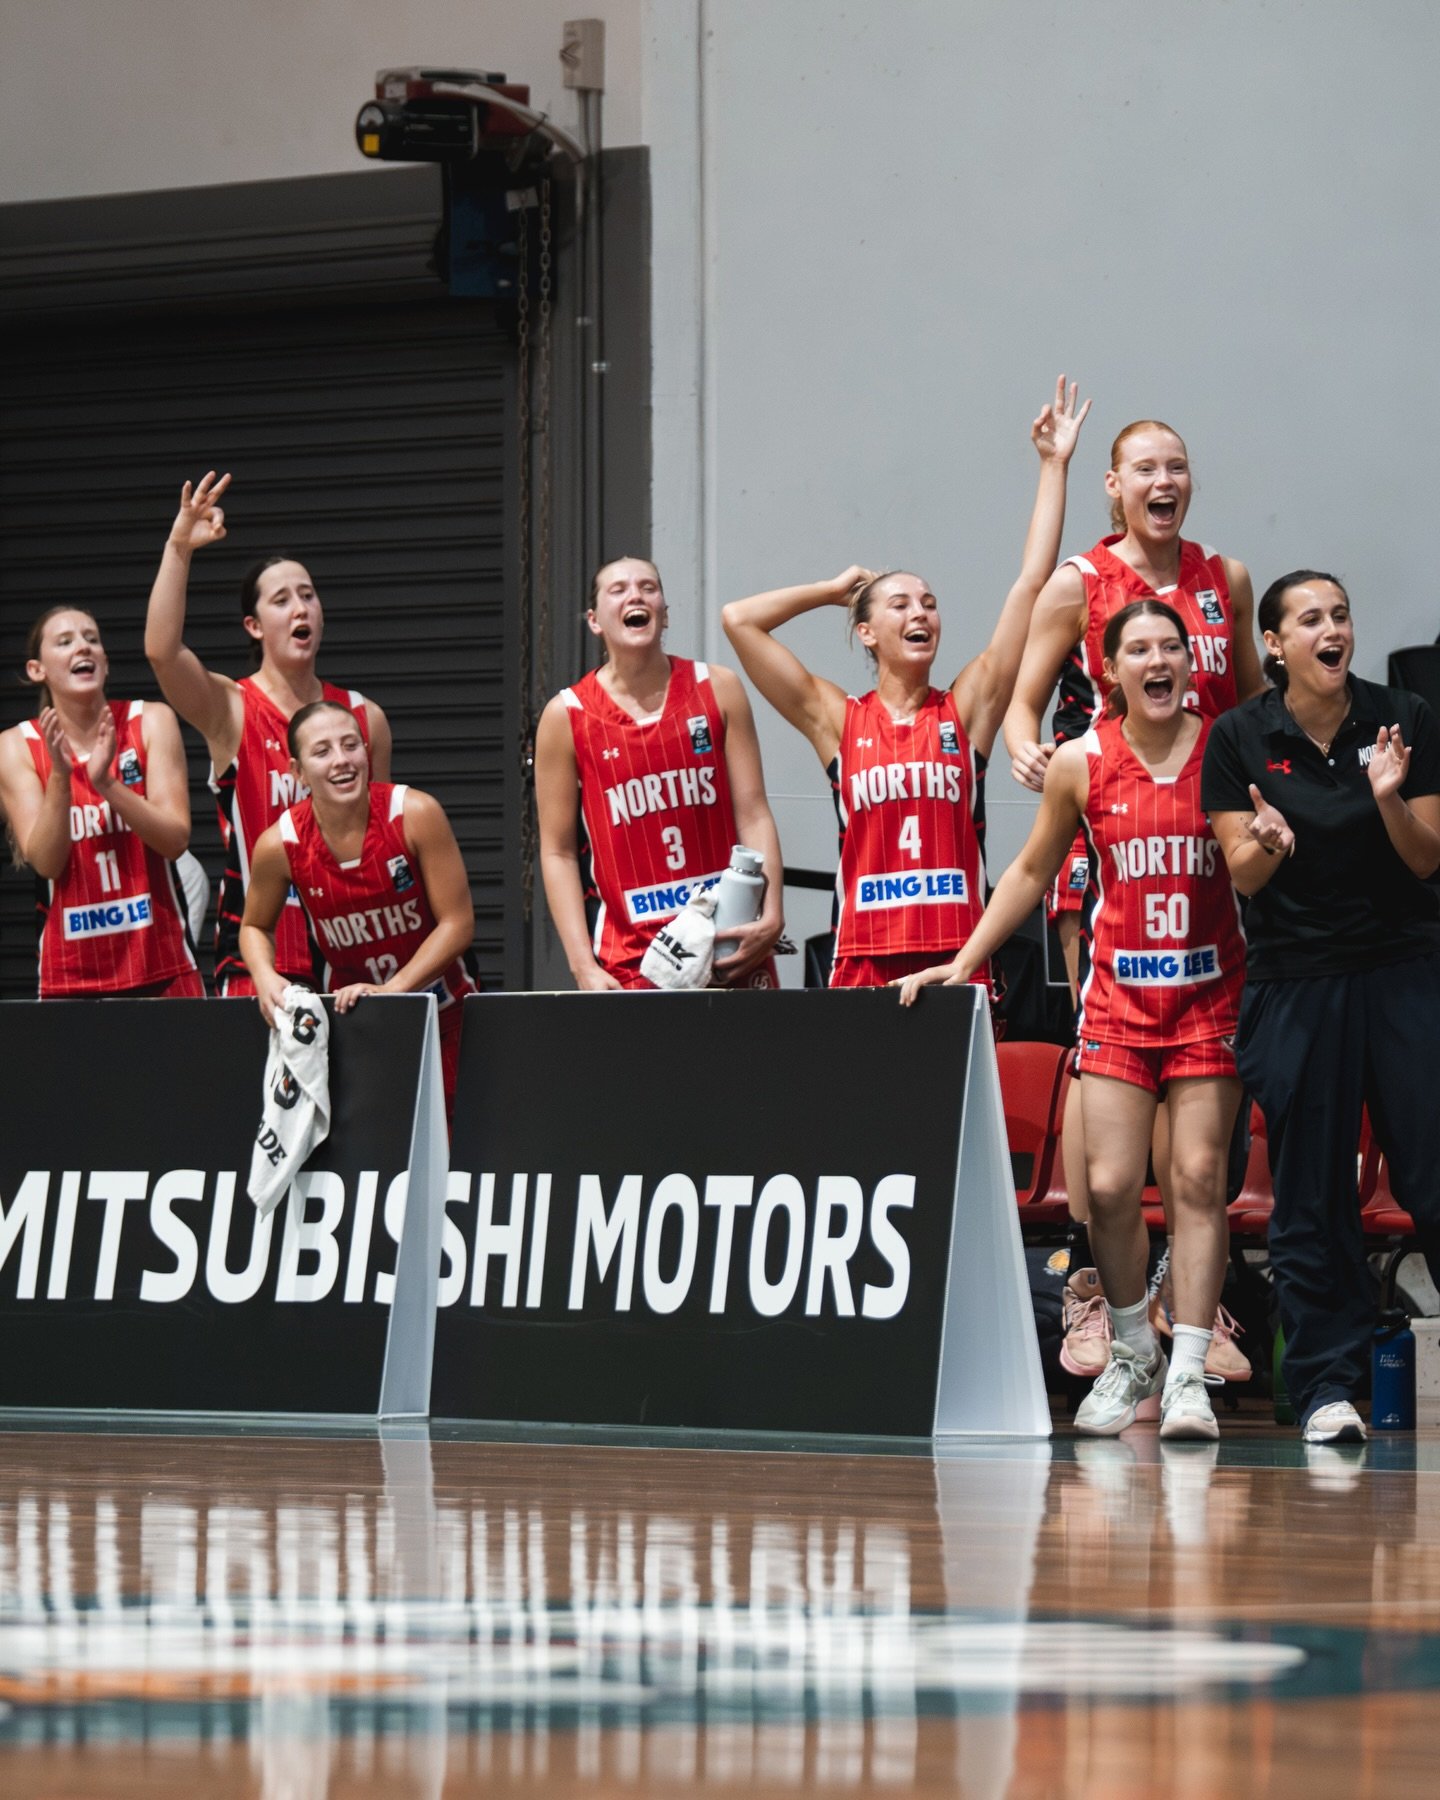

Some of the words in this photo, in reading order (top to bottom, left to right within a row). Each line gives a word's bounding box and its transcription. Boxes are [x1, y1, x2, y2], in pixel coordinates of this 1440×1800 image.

[605, 766, 717, 826] NORTHS
[850, 761, 962, 812] NORTHS
[661, 825, 686, 870] 3
[899, 815, 922, 860] 4
[1109, 835, 1219, 884] NORTHS
[95, 849, 121, 893] 11
[861, 878, 922, 903] BING
[926, 874, 965, 897] LEE
[69, 906, 124, 932] BING
[631, 886, 691, 915] BING
[1145, 893, 1190, 940] 50
[318, 898, 423, 950] NORTHS
[365, 953, 399, 985] 12
[1118, 955, 1178, 979] BING
[1184, 950, 1216, 976] LEE
[568, 1173, 917, 1319] MOTORS
